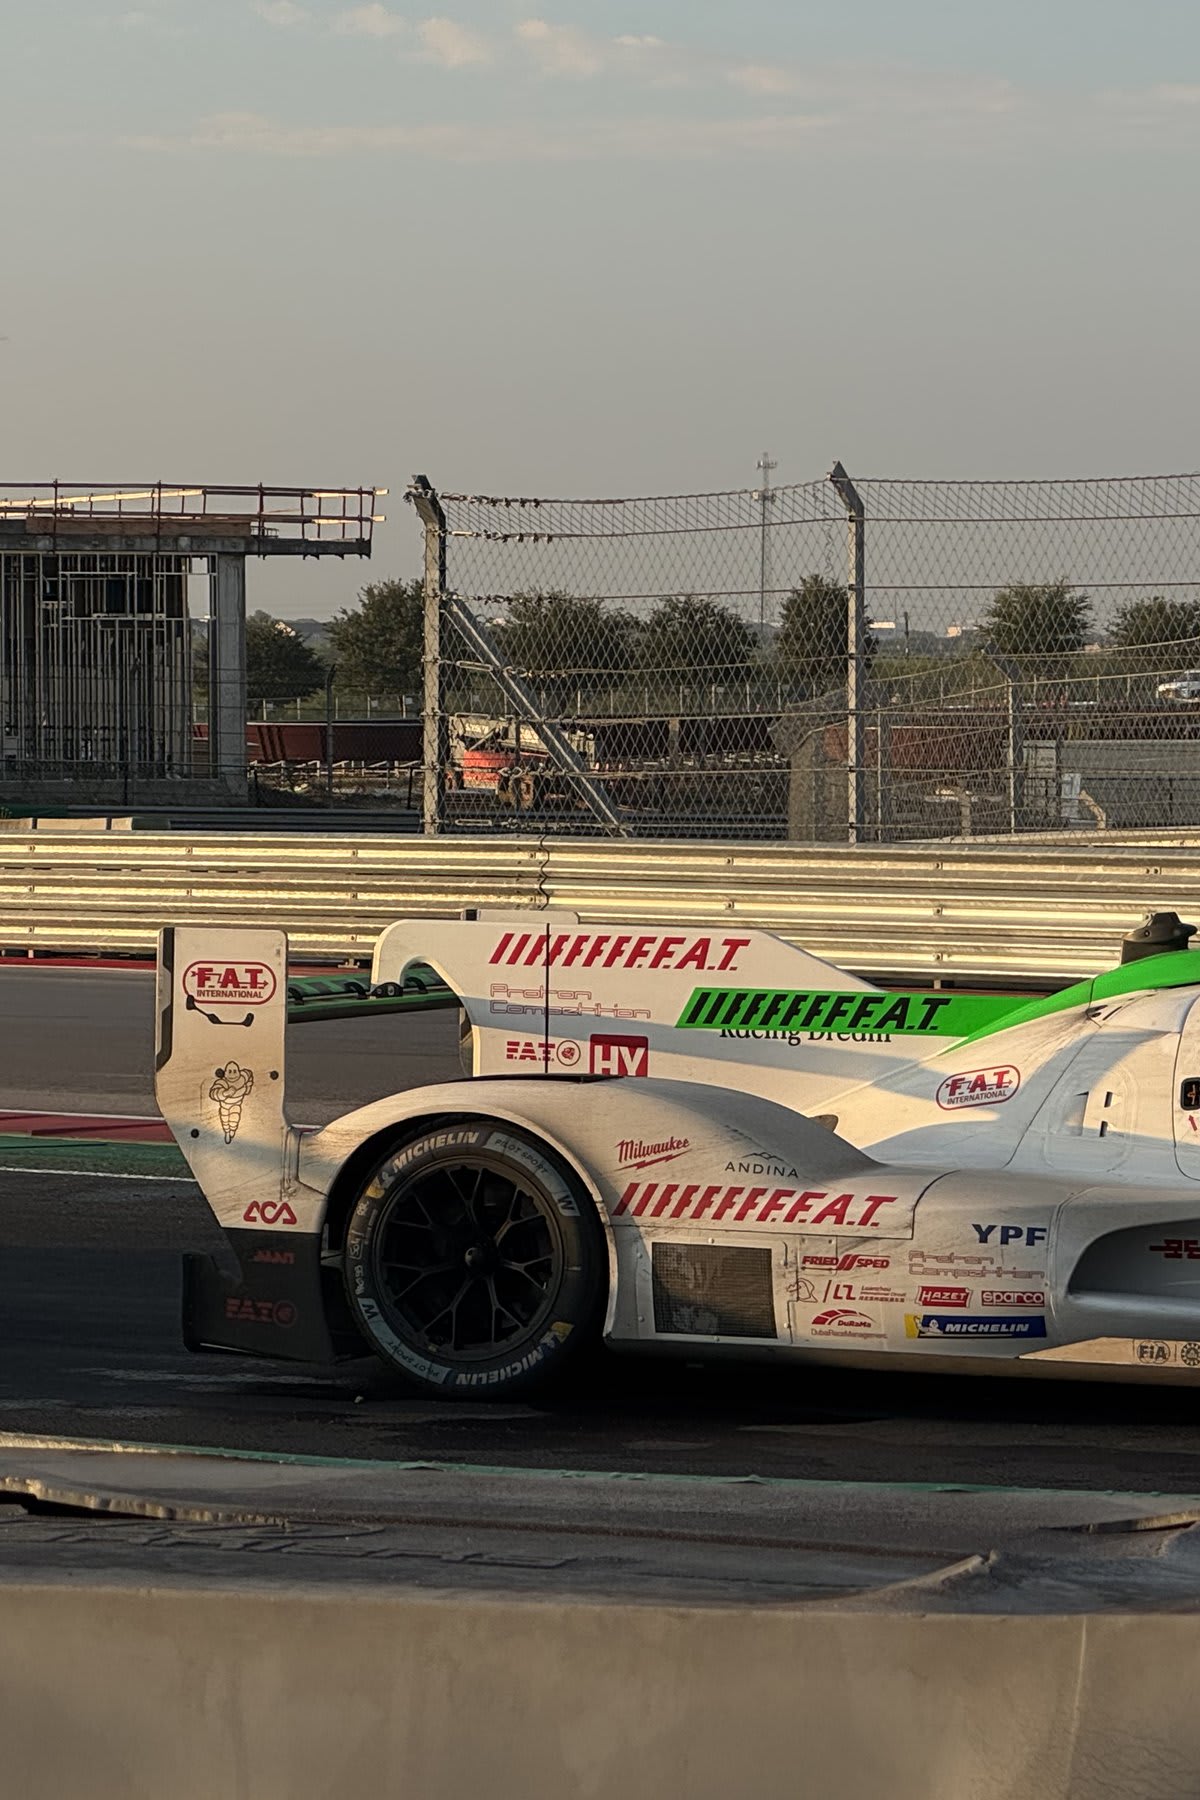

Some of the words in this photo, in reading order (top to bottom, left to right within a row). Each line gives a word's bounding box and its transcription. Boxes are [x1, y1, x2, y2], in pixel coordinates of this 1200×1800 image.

[196, 988, 264, 999] INTERNATIONAL
[946, 1089, 1007, 1105] INTERNATIONAL
[392, 1131, 480, 1174] MICHELIN
[615, 1136, 690, 1163] Milwaukee
[724, 1161, 799, 1178] ANDINA
[972, 1223, 1047, 1247] YPF
[921, 1290, 967, 1304] HAZET
[982, 1291, 1044, 1306] sparco
[945, 1323, 1030, 1333] MICHELIN
[1139, 1345, 1168, 1360] FIA
